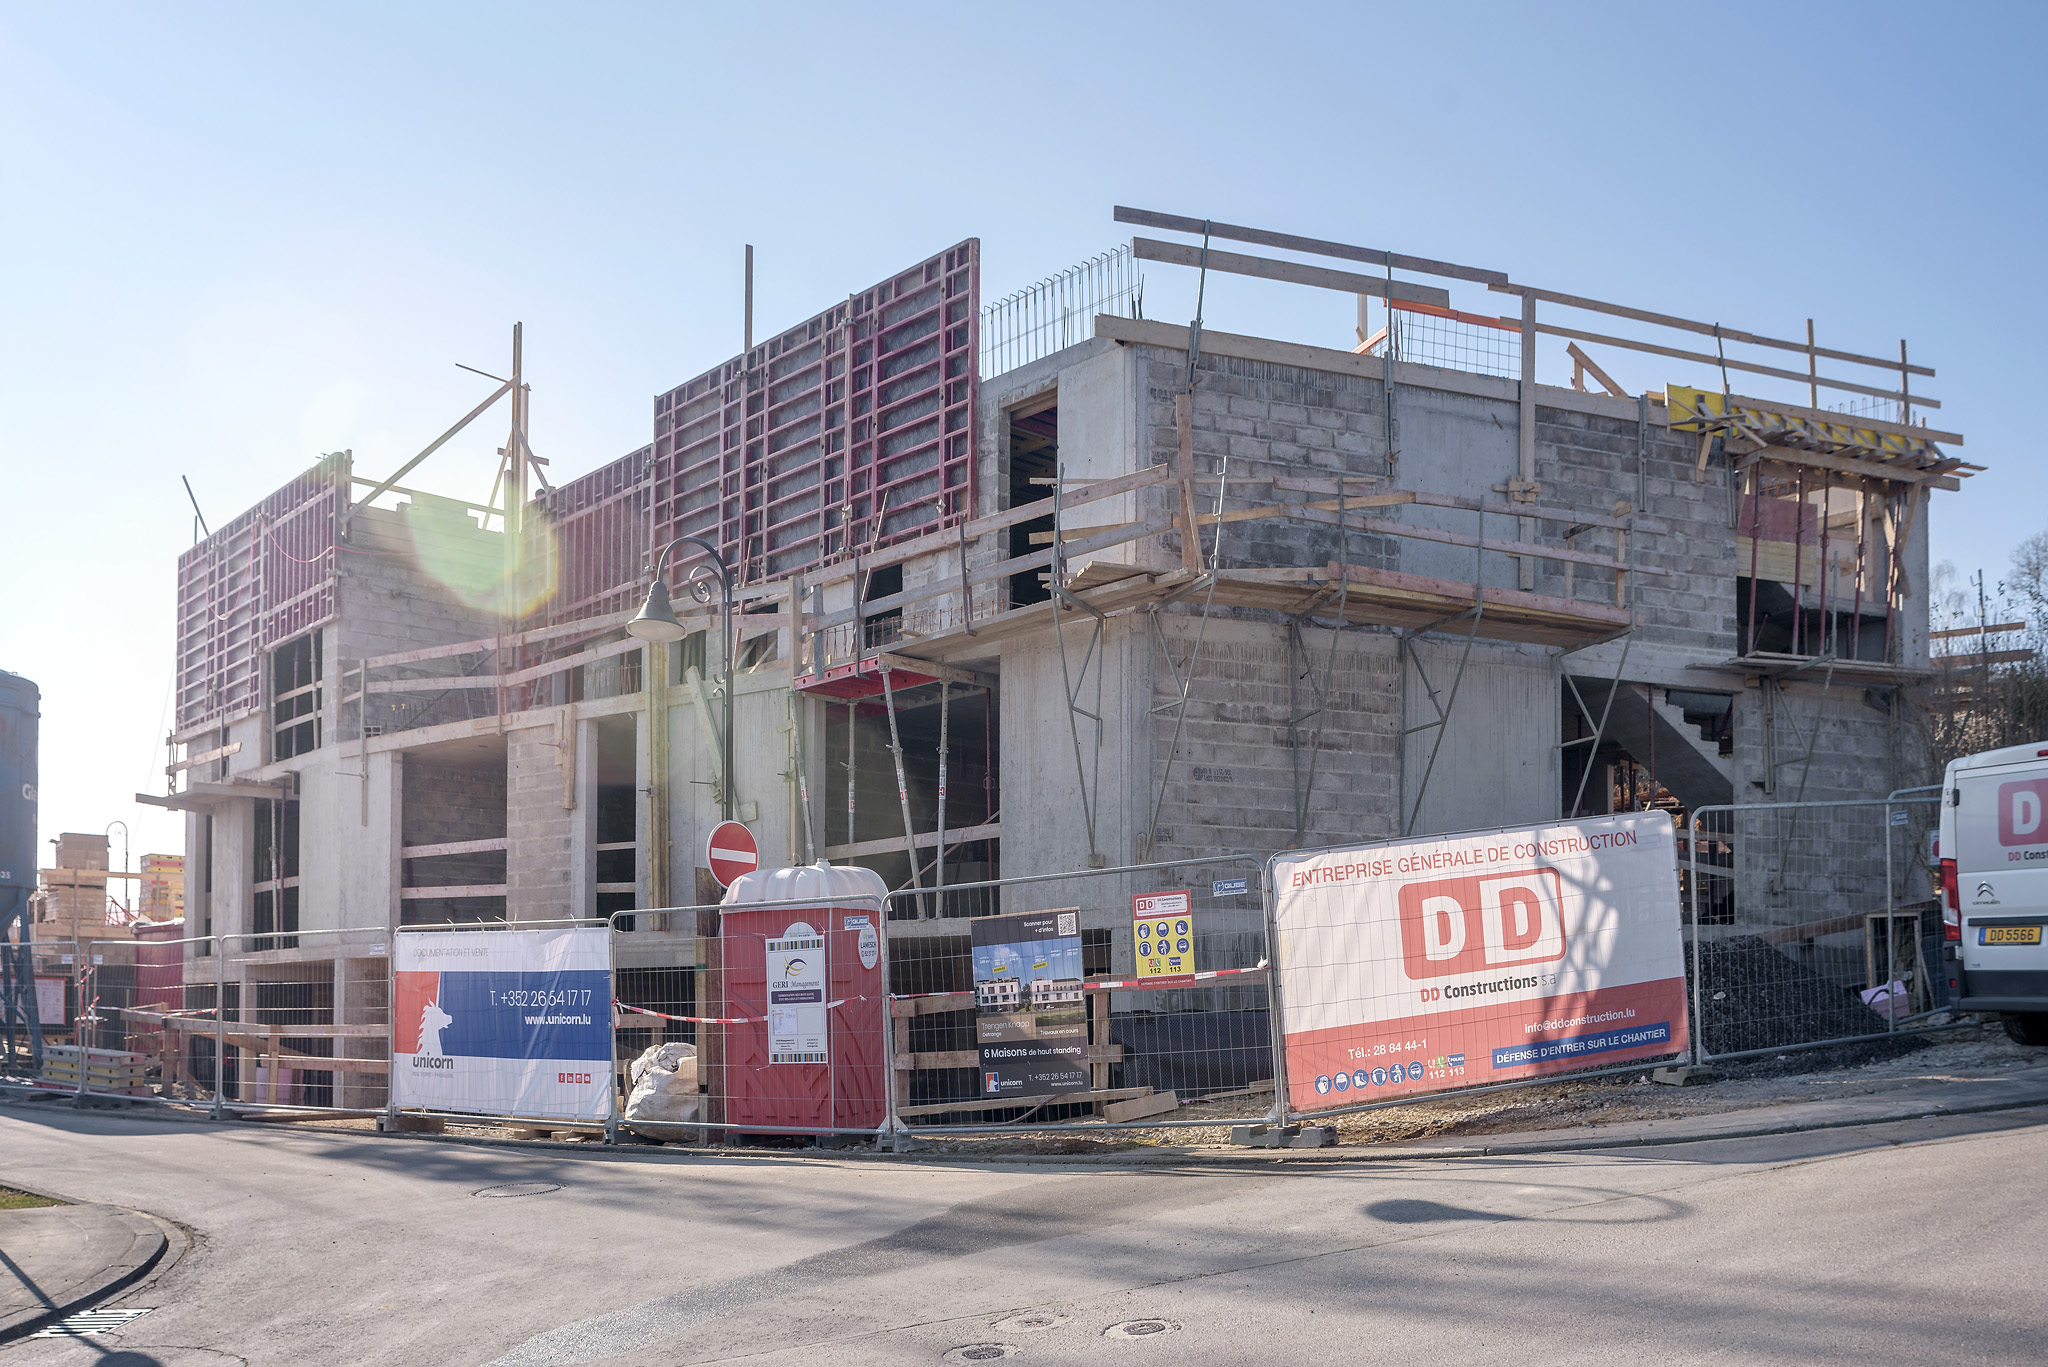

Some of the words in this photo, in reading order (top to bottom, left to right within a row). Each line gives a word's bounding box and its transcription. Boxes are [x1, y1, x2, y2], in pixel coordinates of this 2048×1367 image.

[1293, 859, 1393, 888] ENTREPRISE
[1397, 849, 1484, 873] GÉNÉRALE
[1487, 846, 1510, 863] DE
[1514, 830, 1637, 859] CONSTRUCTION
[2007, 851, 2022, 861] DD
[1990, 929, 2004, 941] DD
[2006, 929, 2034, 941] 5566
[413, 948, 463, 958] DOCUMENTATION
[463, 947, 470, 957] ET
[471, 947, 489, 957] VENTE
[772, 980, 789, 989] GERI
[1420, 987, 1441, 1003] DD
[1444, 975, 1538, 1000] Constructions
[489, 990, 498, 1006] T.
[500, 990, 528, 1006] +352
[530, 990, 547, 1006] 26
[548, 990, 565, 1006] 54
[567, 989, 578, 1006] 17
[581, 989, 592, 1006] 17
[524, 1013, 591, 1025] www.unicorn.lu
[1525, 1008, 1636, 1034] info@ddconstruction.lu
[981, 1021, 1007, 1031] Trengen
[1008, 1020, 1030, 1030] Knapp
[984, 1048, 990, 1058] 6
[991, 1047, 1028, 1058] Maisons
[1037, 1048, 1053, 1056] haut
[1053, 1046, 1082, 1055] standing
[1347, 1047, 1371, 1060] Tél.:
[1373, 1045, 1387, 1056] 28
[1389, 1043, 1402, 1054] 84
[1404, 1038, 1427, 1051] 44-1
[1496, 1048, 1539, 1064] DÉFENSE
[1540, 1042, 1586, 1057] D'ENTRER
[1587, 1038, 1607, 1050] SUR
[1609, 1035, 1620, 1045] LE
[1621, 1028, 1666, 1044] CHANTIER
[412, 1051, 454, 1070] unicorn
[1035, 1073, 1050, 1081] +352
[1428, 1069, 1446, 1079] 112
[1448, 1066, 1465, 1077] 113
[1000, 1078, 1023, 1086] unicorn
